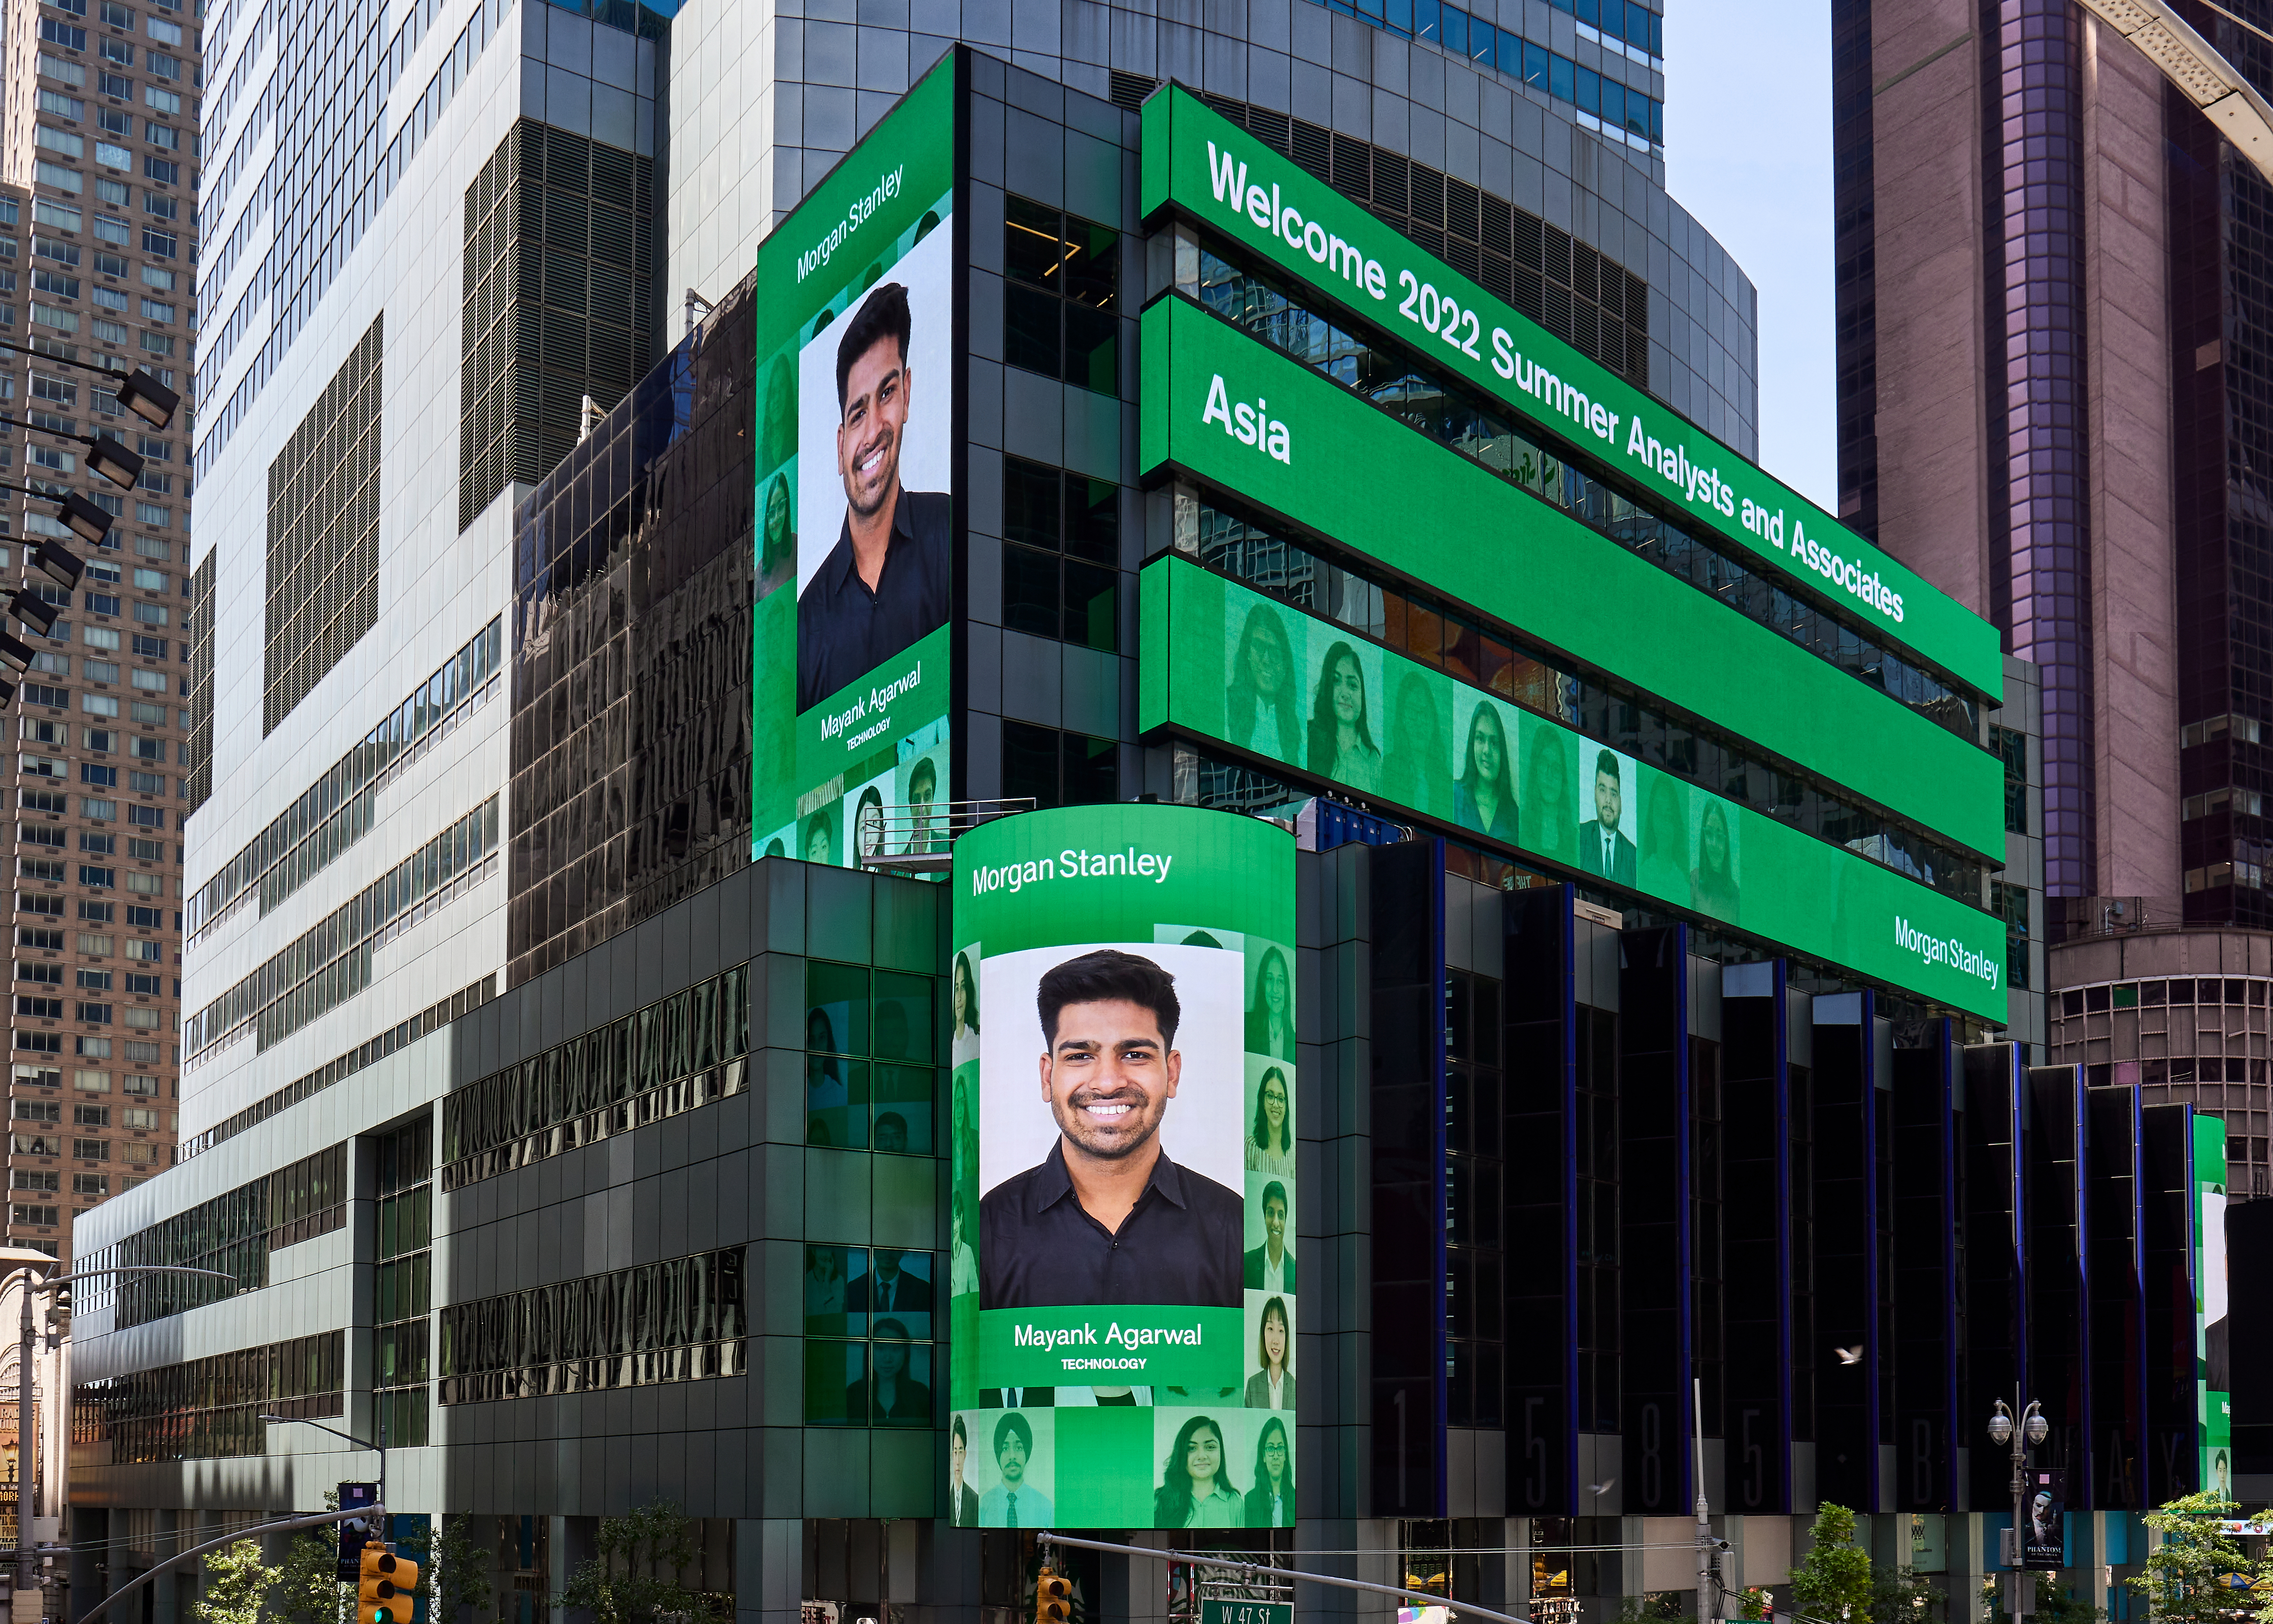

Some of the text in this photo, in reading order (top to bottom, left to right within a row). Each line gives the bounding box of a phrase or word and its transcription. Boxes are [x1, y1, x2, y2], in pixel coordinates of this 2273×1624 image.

[797, 164, 903, 284] Morgan Stanley
[1207, 140, 1904, 623] Welcome 2022 Summer Analysts and Associates
[1201, 374, 1291, 466] Asia
[821, 660, 921, 742] Mayank Agarwal
[846, 716, 891, 751] TECHNOLOGY
[973, 846, 1173, 897] Morgan Stanley
[1895, 915, 1999, 990] Morgan Stanley
[1014, 1321, 1201, 1352] Mayank Agarwal
[1060, 1357, 1147, 1371] TECHNOLOGY
[1222, 1605, 1271, 1624] W 47 St
